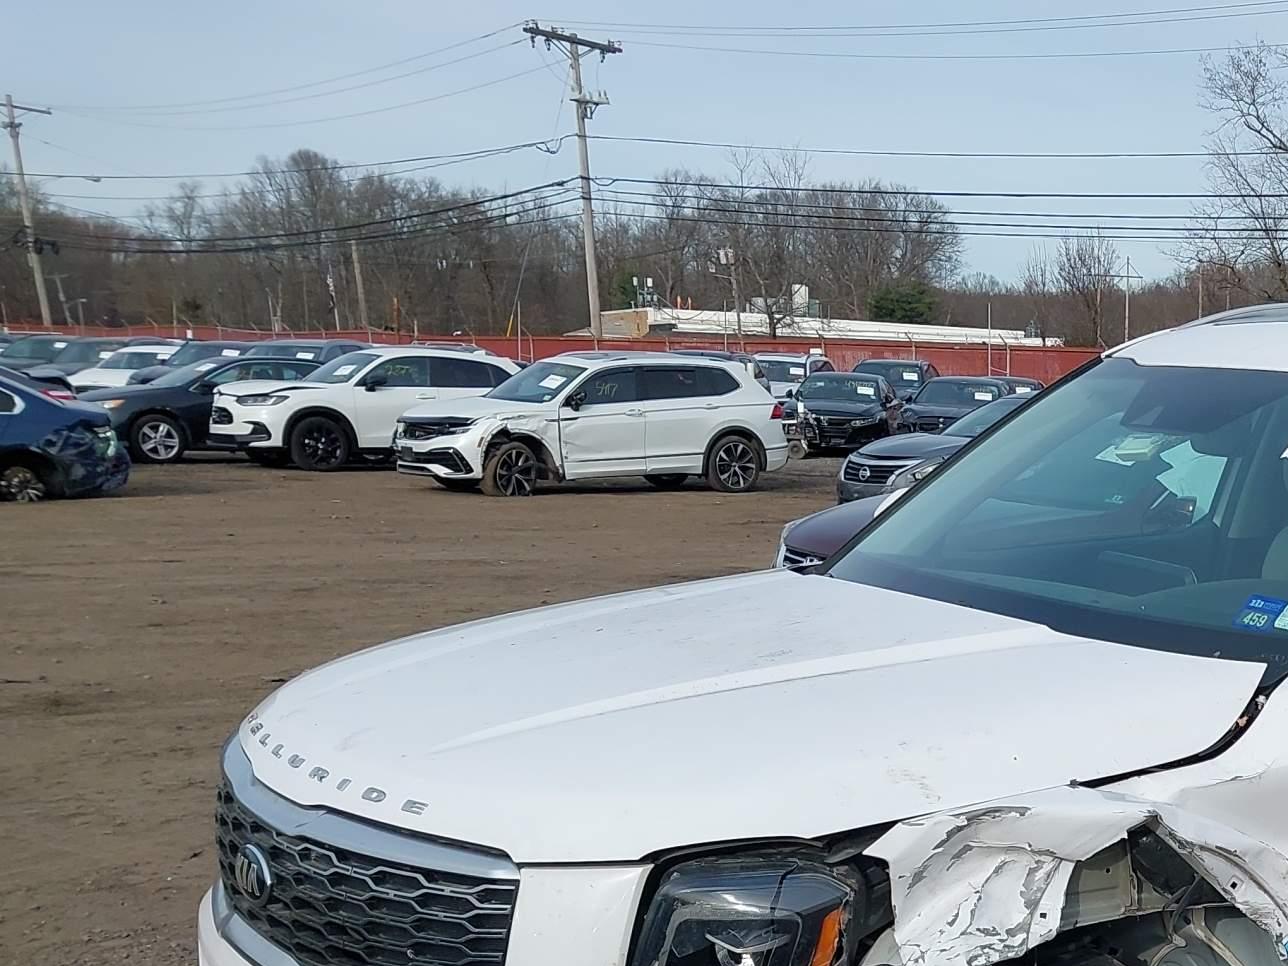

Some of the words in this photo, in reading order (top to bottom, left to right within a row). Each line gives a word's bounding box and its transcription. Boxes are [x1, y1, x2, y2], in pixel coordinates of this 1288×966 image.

[1242, 611, 1268, 627] 459
[247, 712, 430, 816] TELLURIDE
[234, 853, 261, 897] KIA
